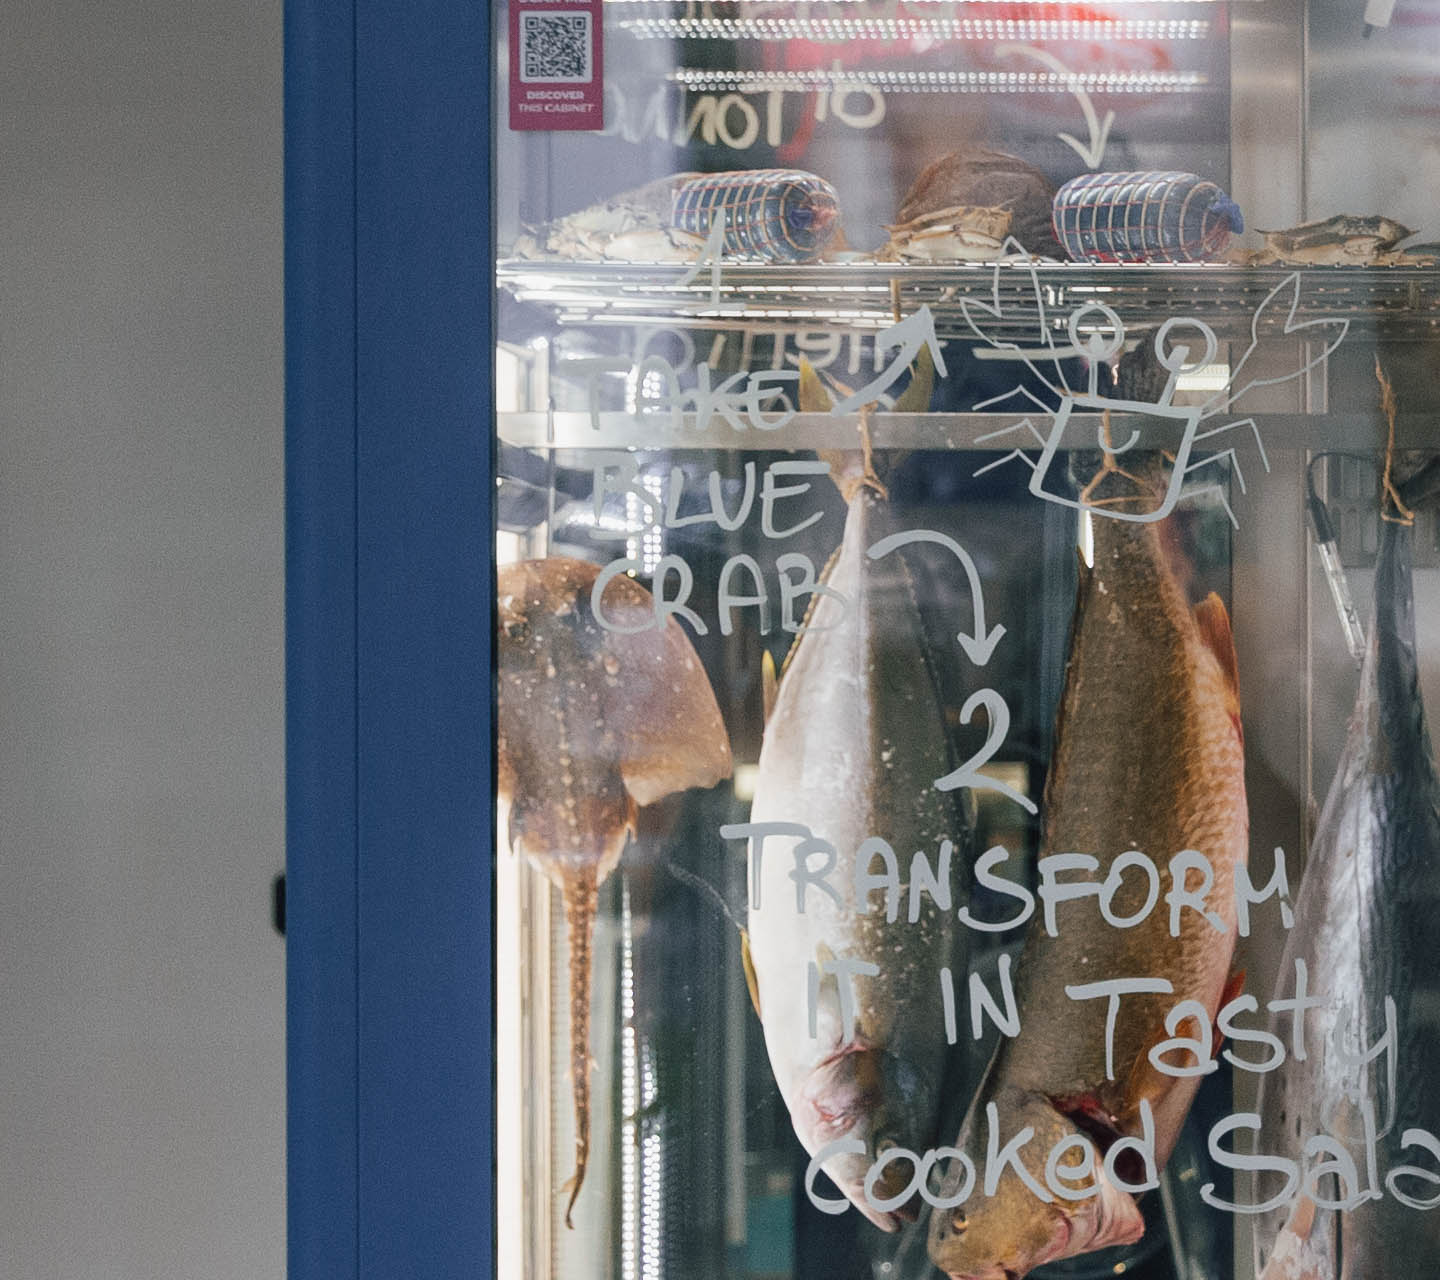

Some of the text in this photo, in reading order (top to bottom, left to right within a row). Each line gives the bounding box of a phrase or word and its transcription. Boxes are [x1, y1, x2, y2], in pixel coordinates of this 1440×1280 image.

[587, 449, 832, 541] BLUE
[590, 551, 854, 637] CRAB
[934, 686, 1039, 815] 2
[719, 820, 1297, 939] TRANSFORM
[805, 952, 1400, 1132] IT IN Tasty
